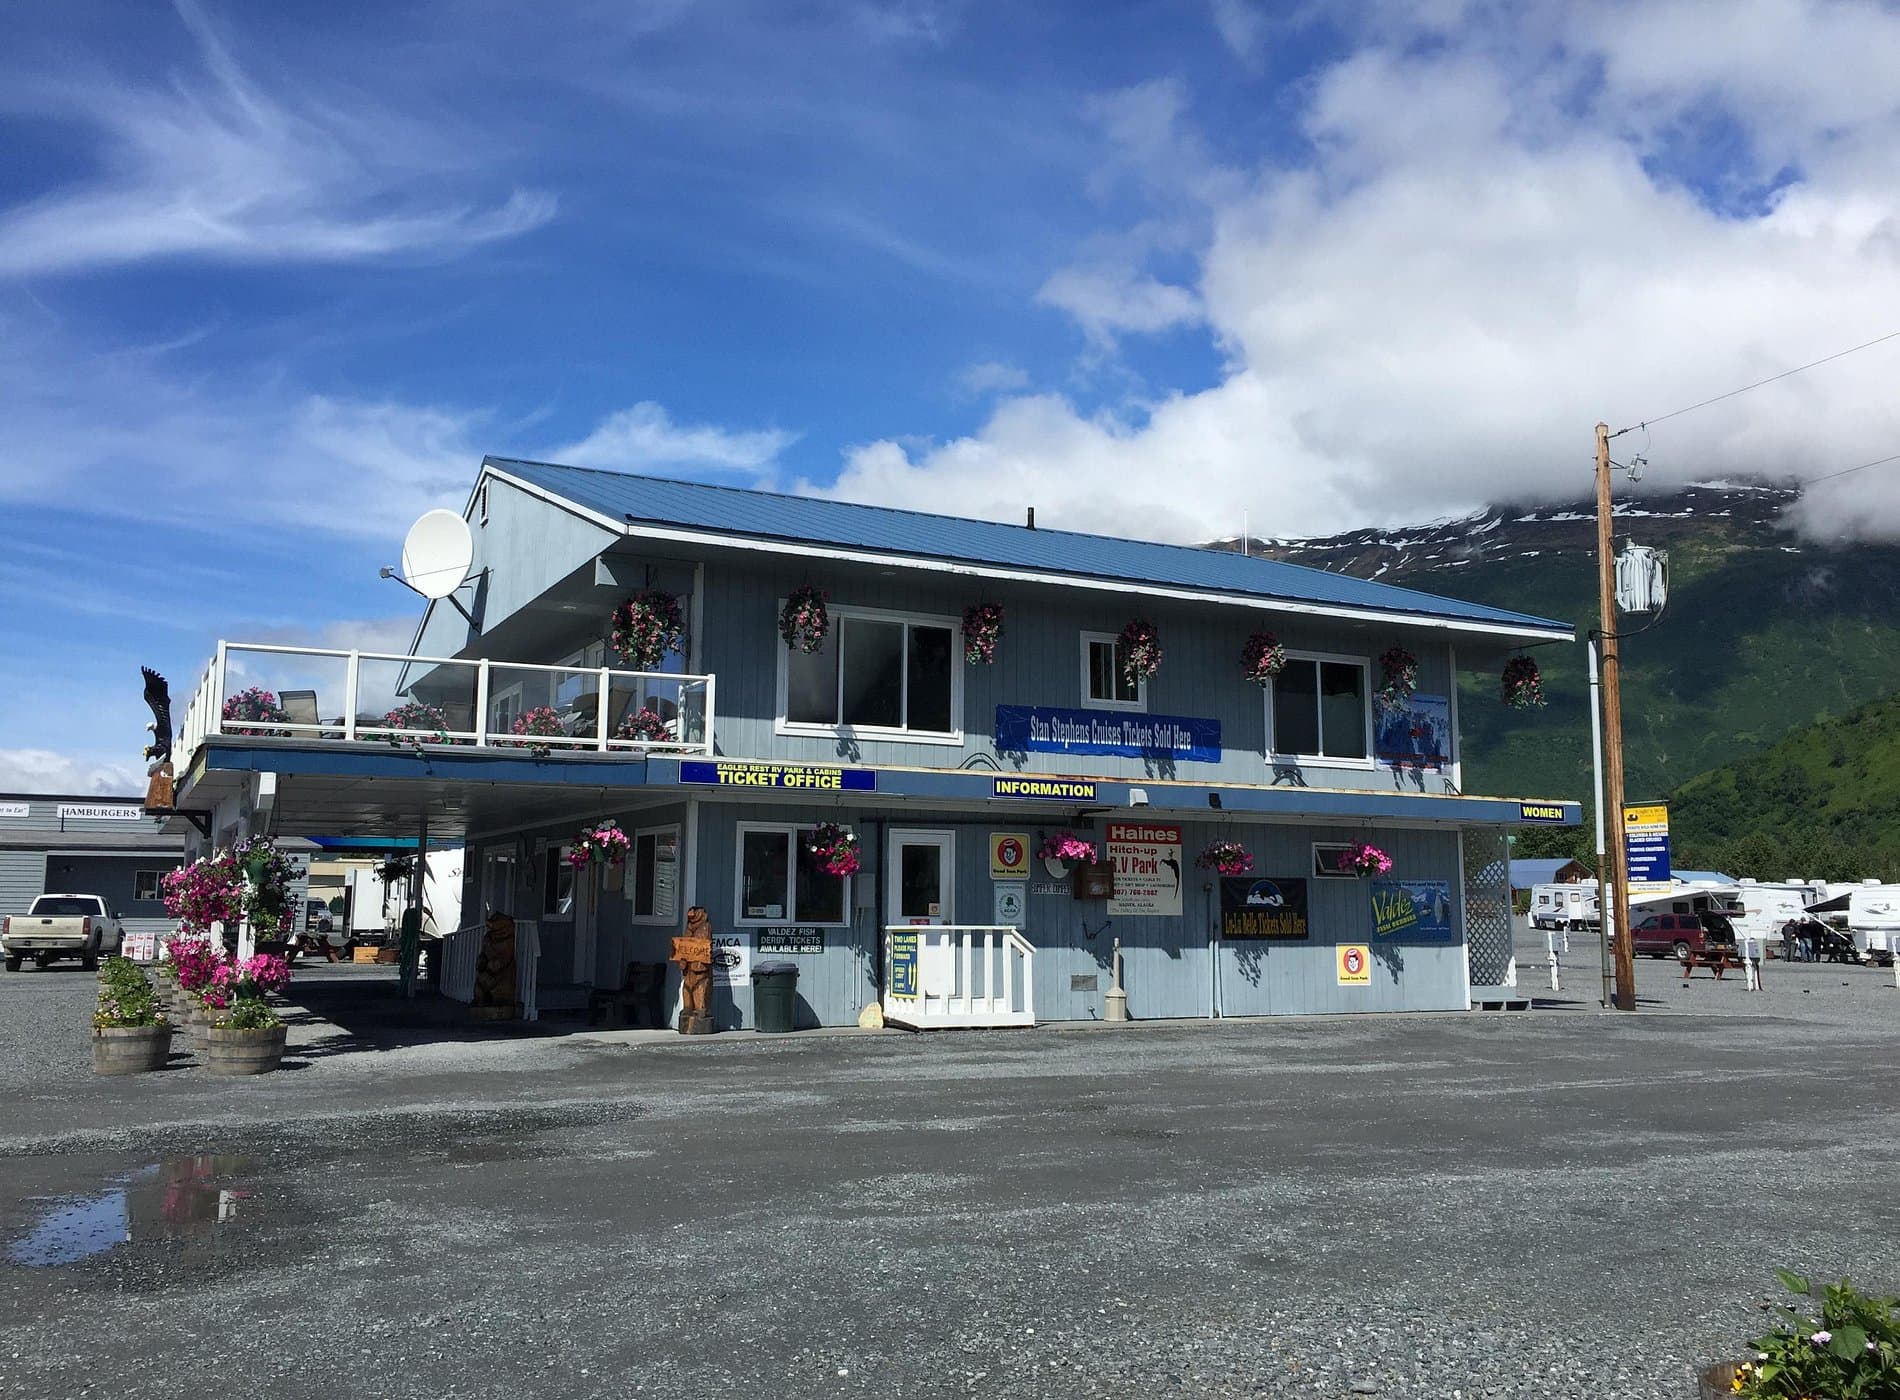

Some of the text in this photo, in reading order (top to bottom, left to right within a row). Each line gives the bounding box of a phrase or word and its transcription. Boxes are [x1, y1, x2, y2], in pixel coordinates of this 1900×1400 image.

[1031, 715, 1191, 750] Stan Stephens Cruises Tickets Sold Here
[750, 765, 770, 773] REST
[814, 768, 842, 776] CABINS
[717, 771, 842, 789] TICKET OFFICE
[996, 781, 1094, 797] INFORMATION
[62, 808, 137, 818] HAMBURGERS
[1522, 806, 1563, 818] WOMEN
[1111, 826, 1178, 841] Haines
[1110, 846, 1157, 856] Hitch-up
[1132, 857, 1158, 874] Park
[1372, 889, 1414, 926] Valdez
[1258, 912, 1279, 934] Tickets
[1280, 912, 1291, 934] Sold
[1292, 912, 1306, 934] Here
[799, 928, 815, 936] FISH
[712, 938, 741, 947] FMCA
[761, 936, 821, 944] DERBY TICKETS
